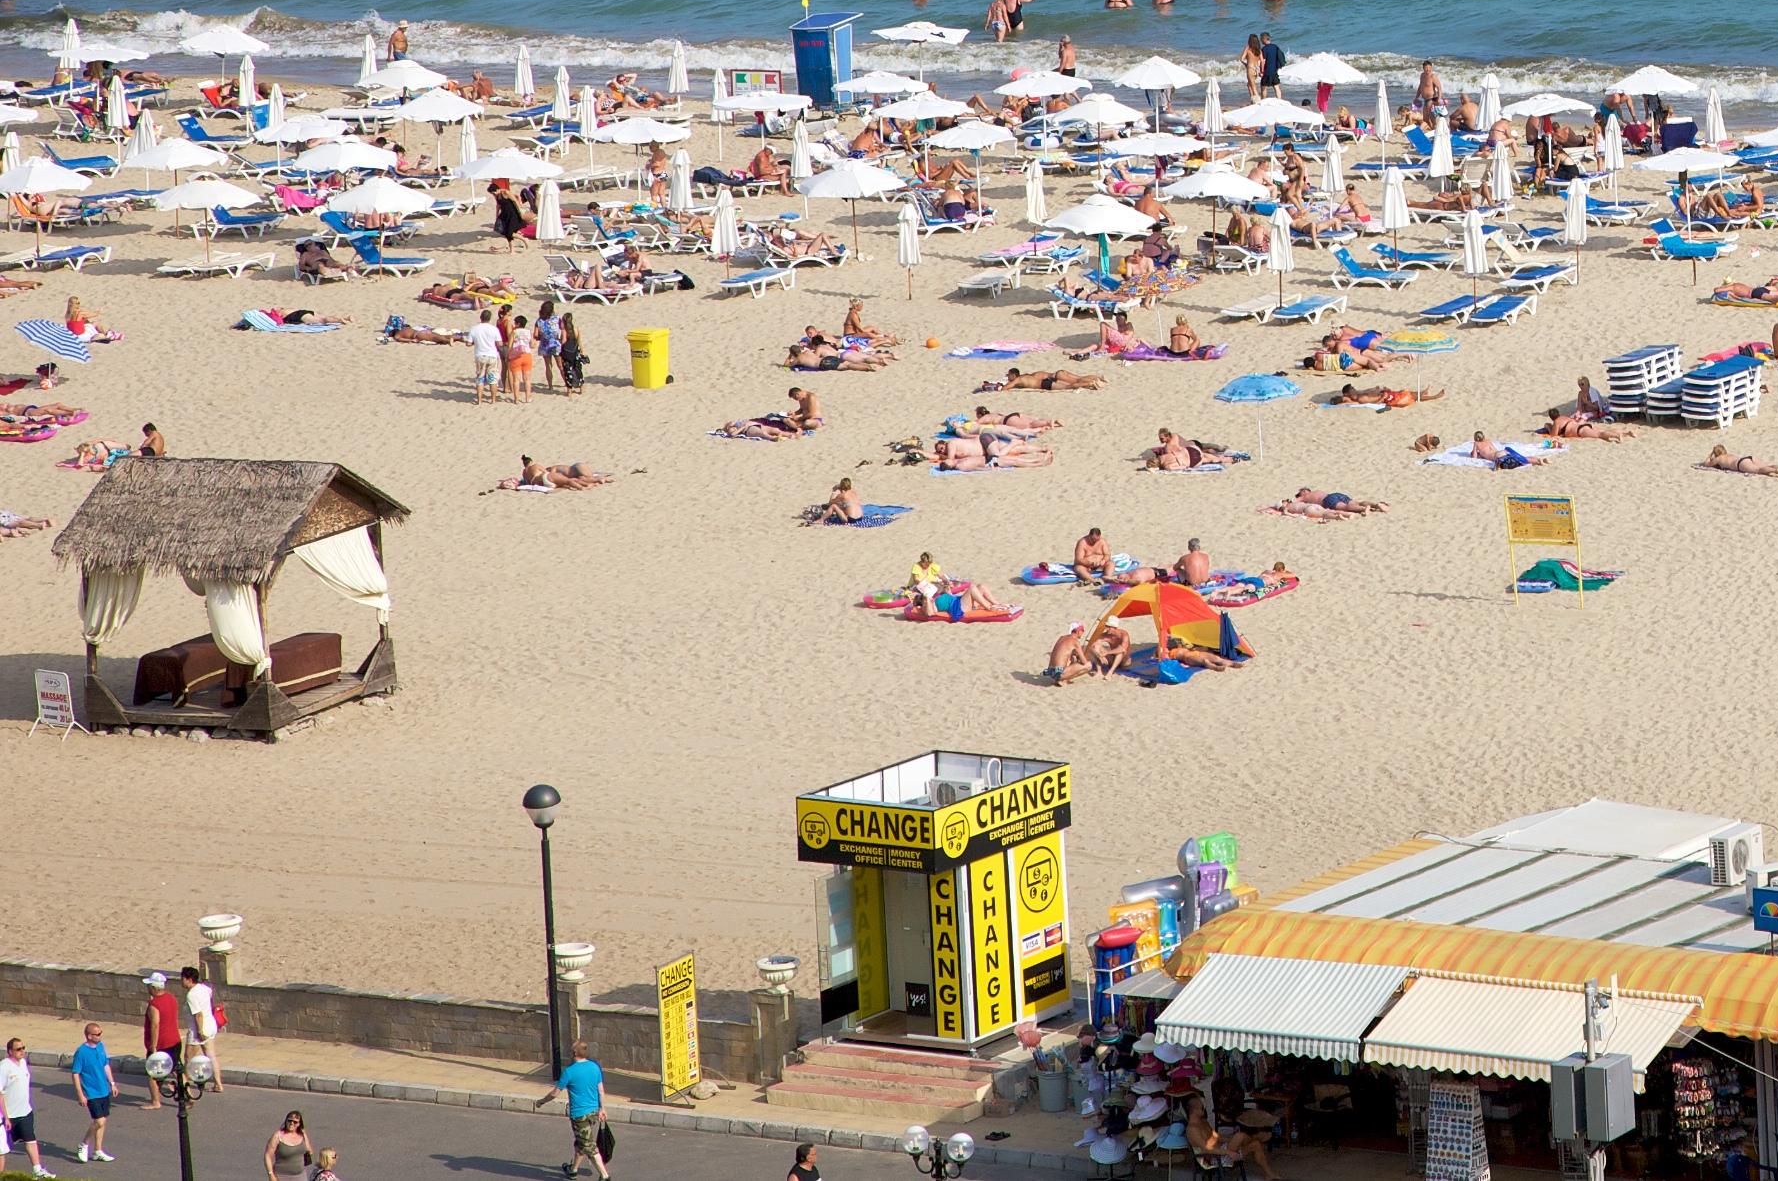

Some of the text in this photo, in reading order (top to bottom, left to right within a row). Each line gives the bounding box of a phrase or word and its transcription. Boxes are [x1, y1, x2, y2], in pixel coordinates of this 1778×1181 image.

[40, 691, 68, 703] MASSAGE
[976, 770, 1067, 829] CHANGE
[1030, 810, 1054, 826] MONEY
[835, 808, 930, 844] CHANGE
[989, 820, 1024, 841] EXCHANGE
[1030, 822, 1055, 836] CENTER
[1001, 831, 1025, 846] OFFICE
[839, 844, 884, 856] EXCHANGE
[890, 849, 921, 859] MONEY
[855, 855, 884, 865] OFFICE
[890, 858, 923, 869] CENTER
[983, 870, 1001, 1025] CHANGE
[1025, 937, 1039, 950] VISA
[935, 878, 957, 1032] CHANGE
[660, 958, 693, 988] CHANGE
[910, 992, 927, 1008] yes!
